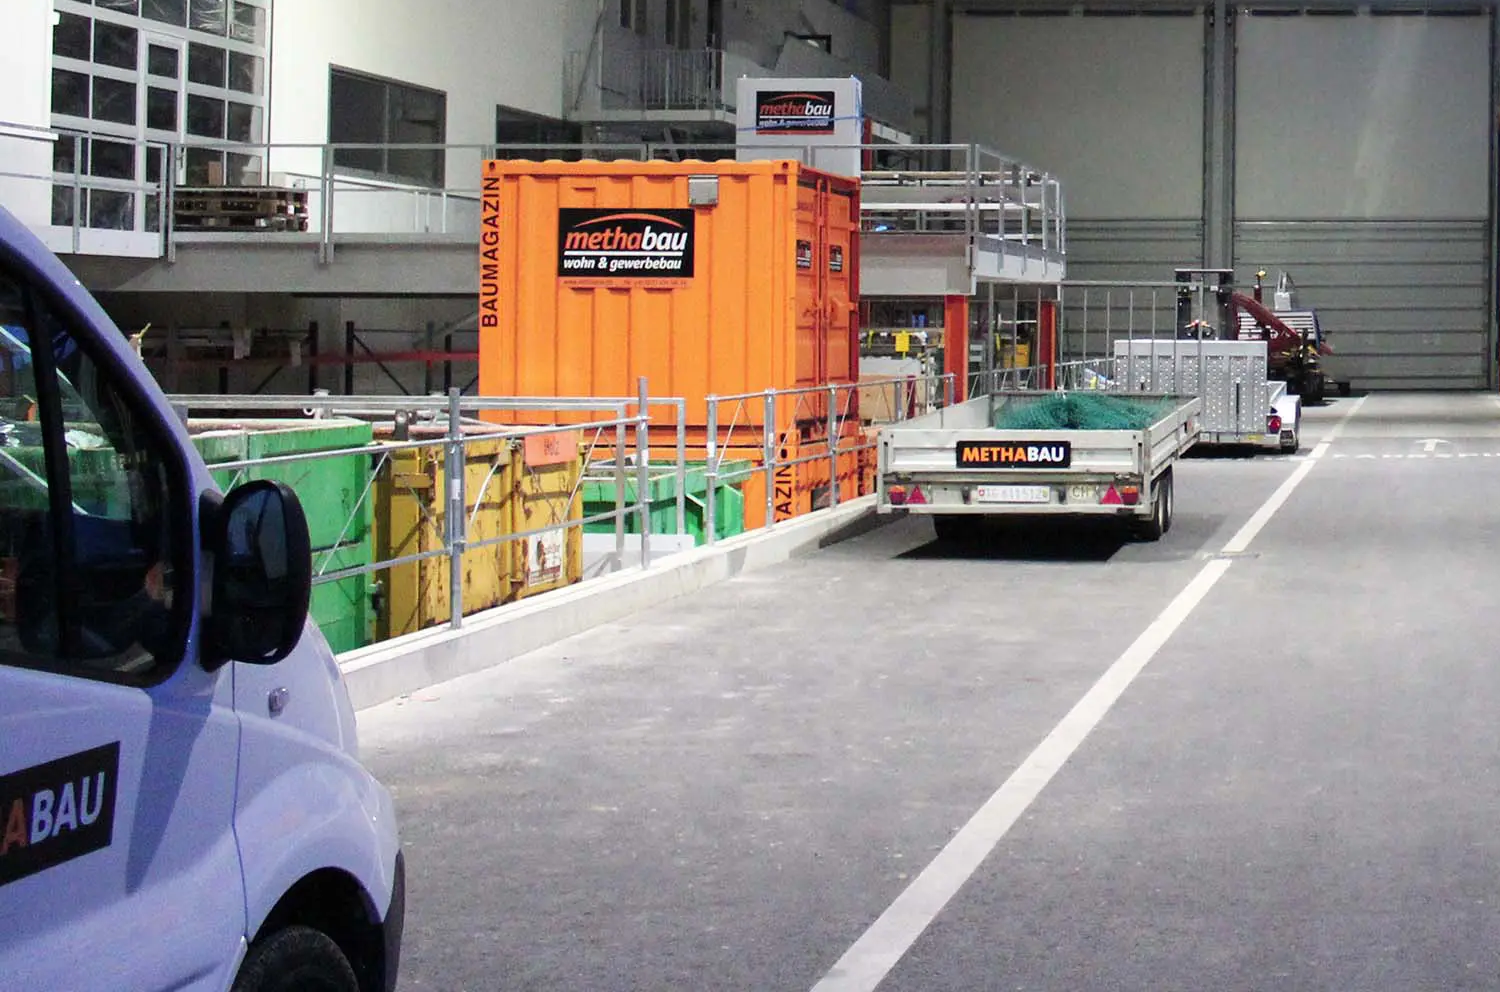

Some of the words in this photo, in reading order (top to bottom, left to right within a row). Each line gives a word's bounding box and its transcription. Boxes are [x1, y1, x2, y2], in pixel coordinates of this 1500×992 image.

[760, 101, 832, 115] methabau
[565, 226, 688, 250] methabau
[482, 177, 499, 327] BAUMAGAZIN
[563, 256, 596, 269] wohn
[598, 257, 608, 269] &
[609, 257, 682, 272] gewerbebau
[962, 447, 1065, 462] METHABAU
[775, 465, 792, 522] AZIN
[0, 772, 105, 855] ABAU
